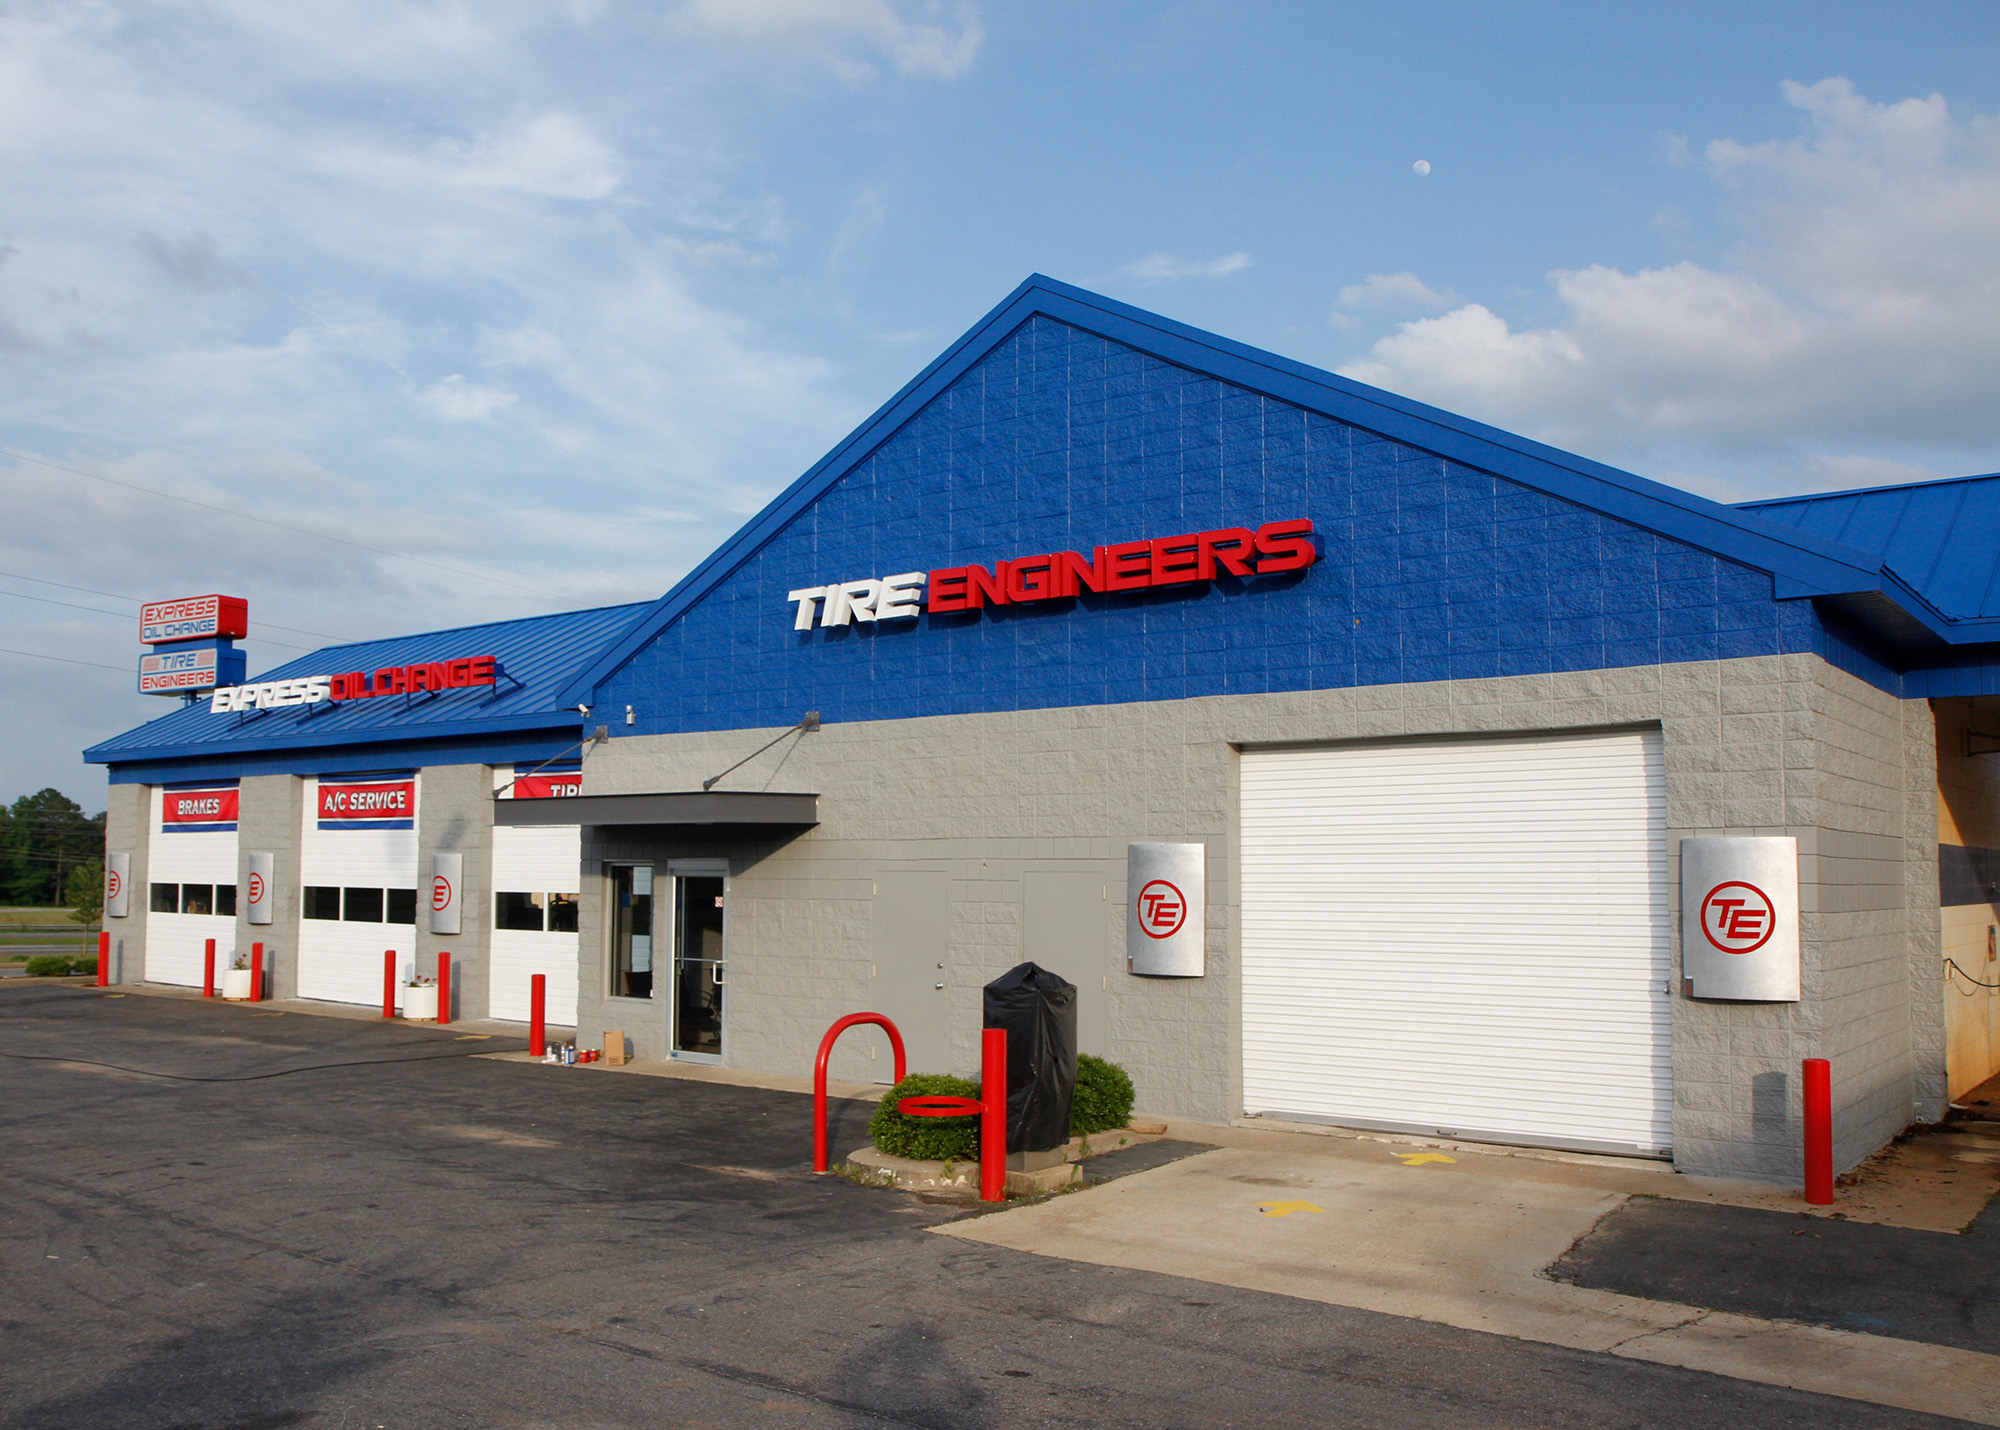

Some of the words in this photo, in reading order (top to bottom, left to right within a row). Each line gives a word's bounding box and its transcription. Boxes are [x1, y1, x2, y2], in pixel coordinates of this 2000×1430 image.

[787, 571, 926, 630] TIRE
[927, 518, 1316, 614] ENGINEERS
[144, 599, 217, 622] EXPRESS
[143, 627, 161, 639] OIL
[164, 619, 216, 637] CHANGE
[162, 653, 197, 670] TIRE
[142, 671, 215, 689] ENGINEERS
[210, 675, 333, 713] EXPRESS
[177, 798, 220, 815] BRAKES
[324, 791, 346, 812] A/C
[349, 790, 406, 811] SERVICE
[1143, 894, 1180, 927] TE
[1711, 899, 1767, 939] TE
